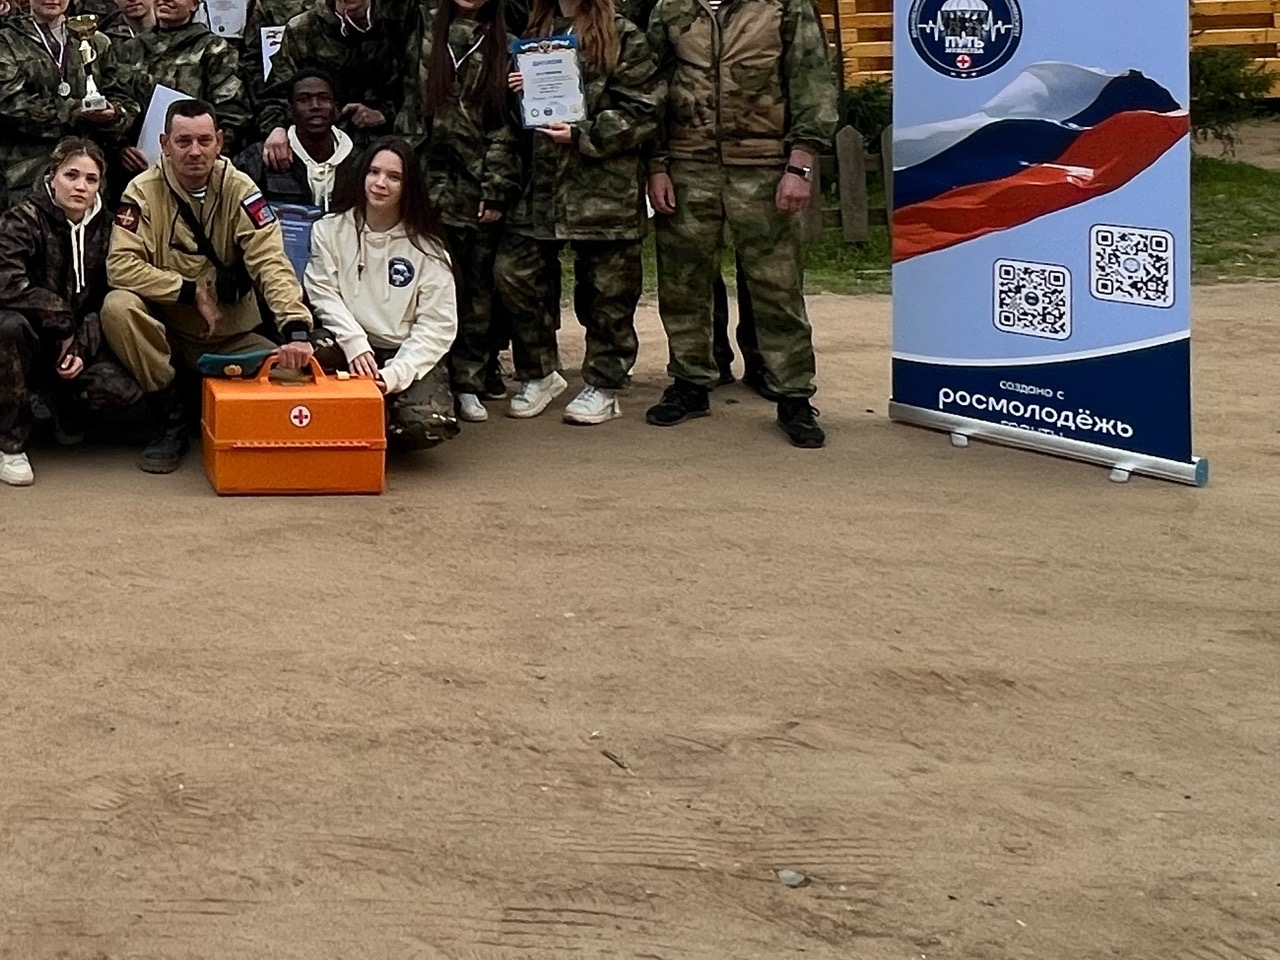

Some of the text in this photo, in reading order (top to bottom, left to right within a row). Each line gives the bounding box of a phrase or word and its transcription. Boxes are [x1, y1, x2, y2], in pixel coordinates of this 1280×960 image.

[945, 35, 985, 48] ПУТЬ
[999, 380, 1065, 400] создано с
[938, 387, 1134, 439] росмолодёжь
